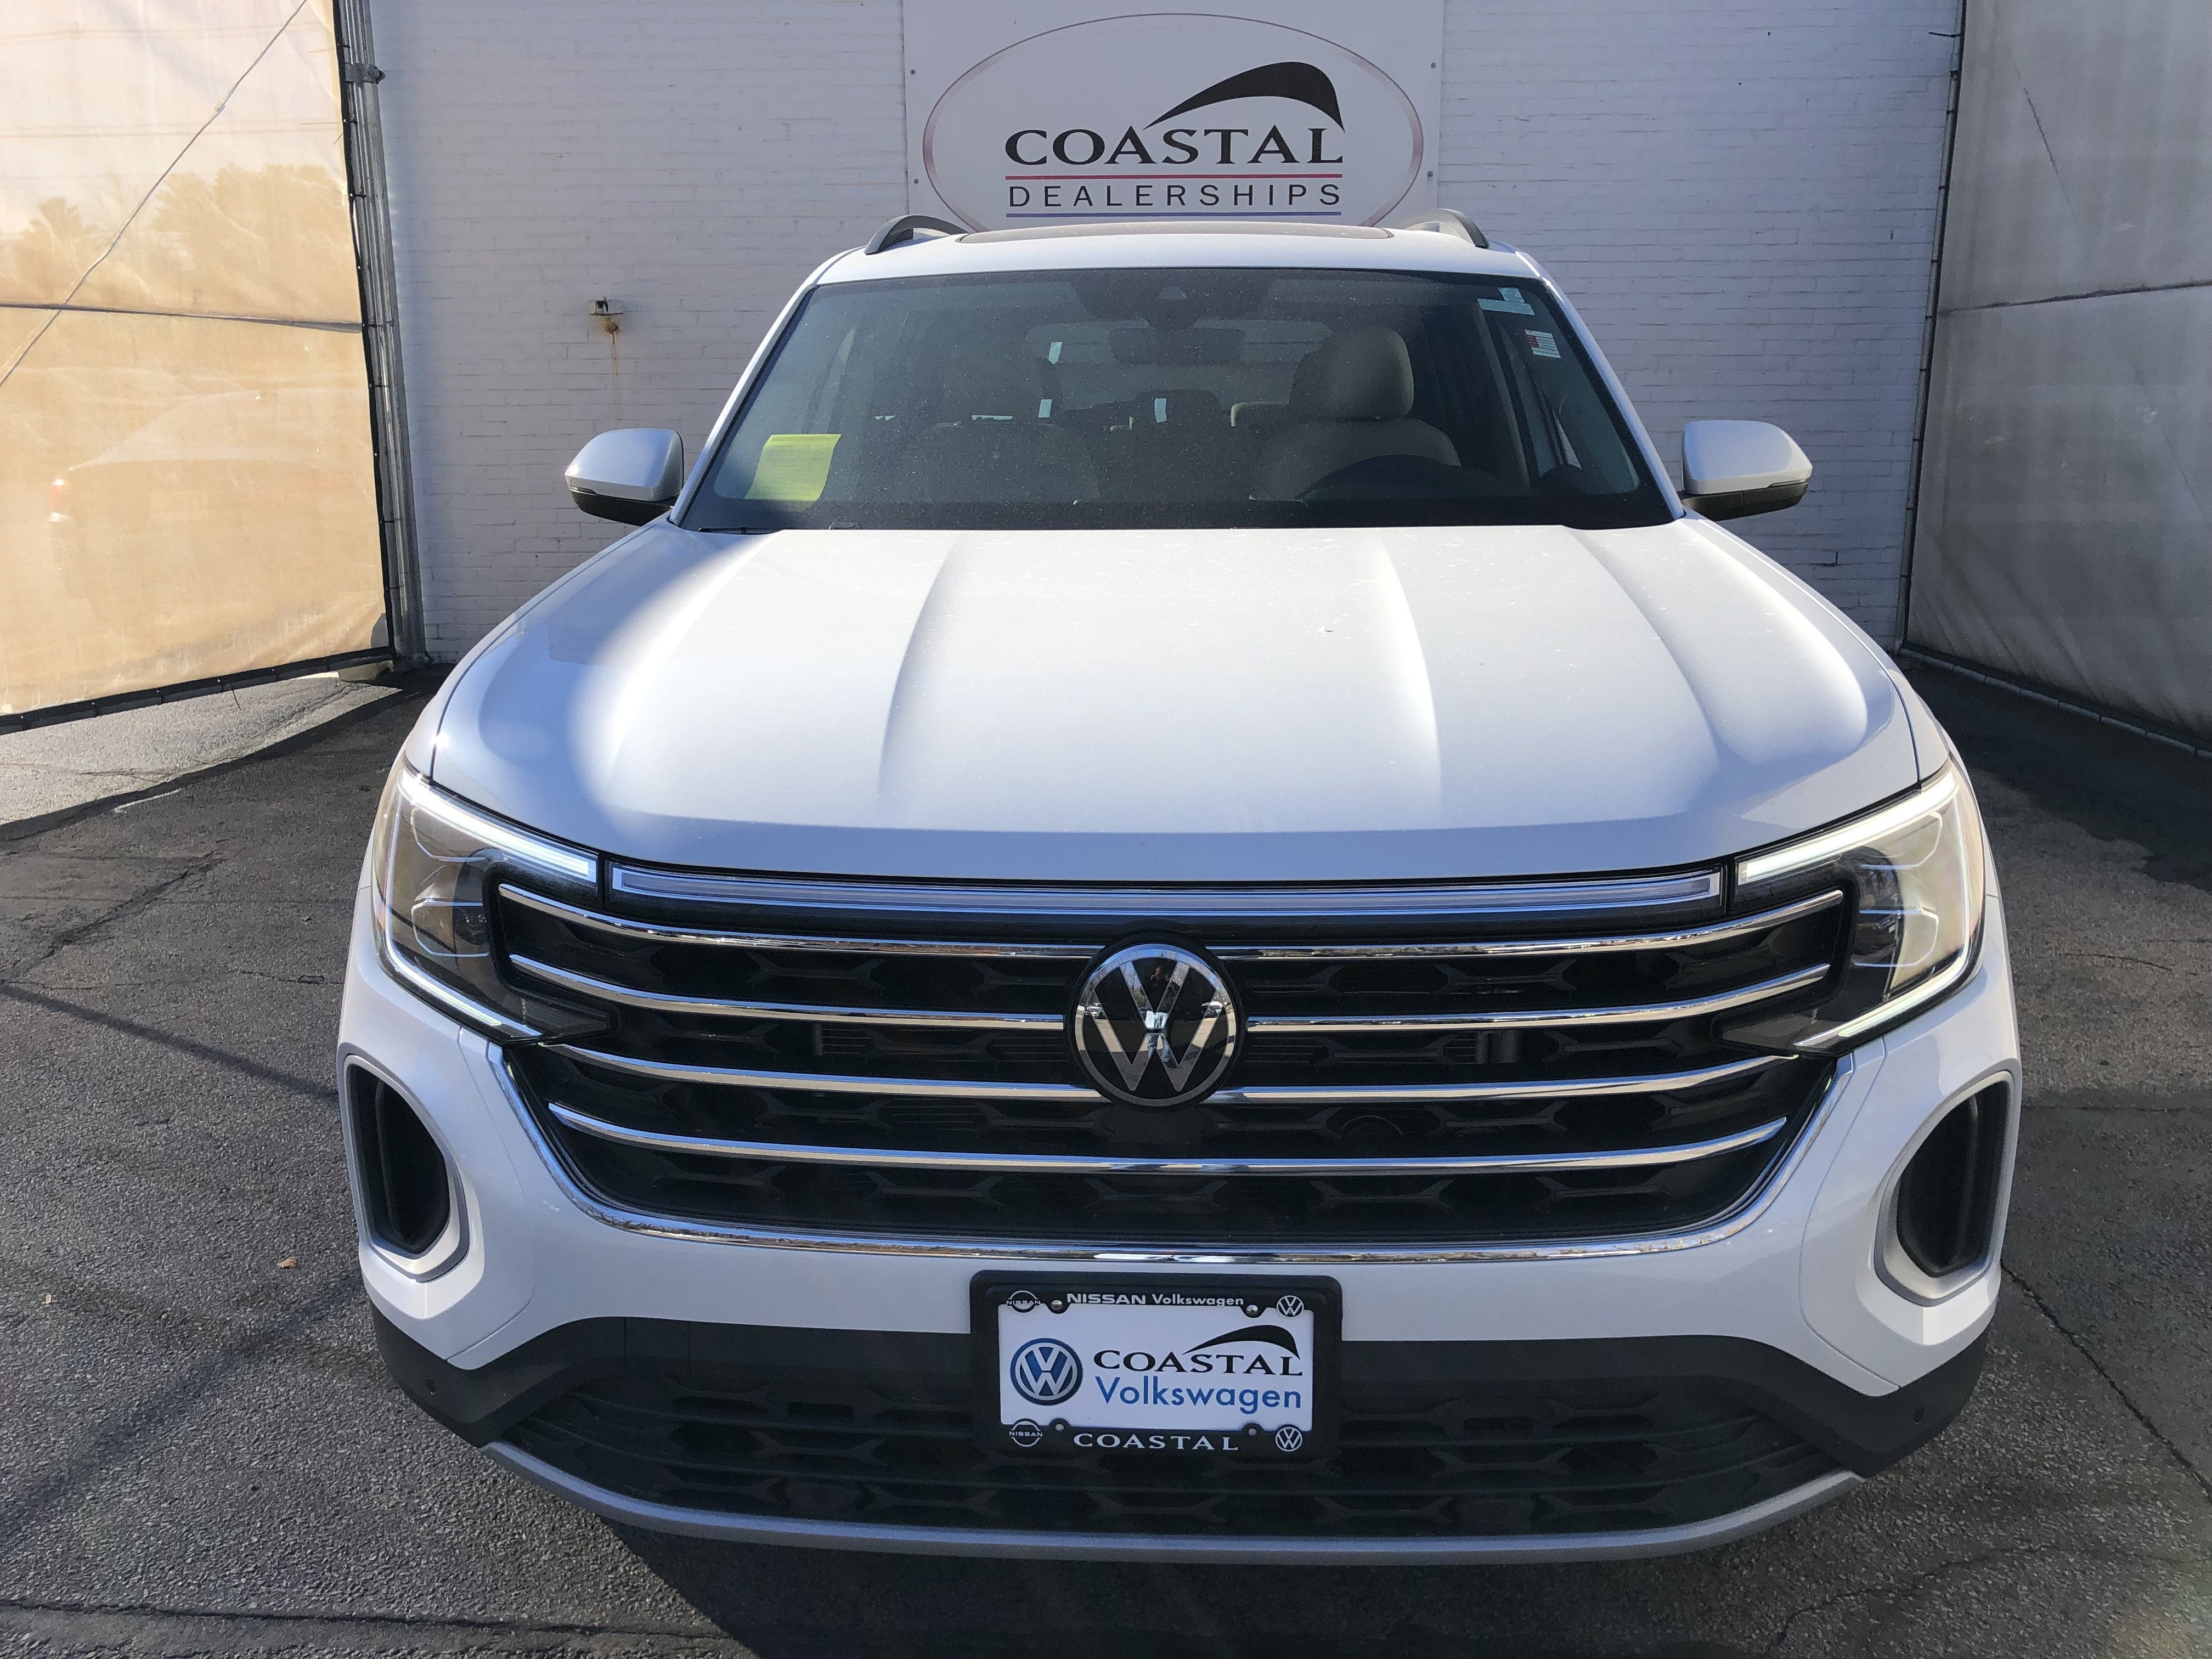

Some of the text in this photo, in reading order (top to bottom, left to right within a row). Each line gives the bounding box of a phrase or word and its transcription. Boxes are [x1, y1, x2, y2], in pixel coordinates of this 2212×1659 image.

[1005, 125, 1344, 165] COASTAL
[1010, 184, 1340, 207] DEALERSHIPS
[1082, 958, 1227, 1093] VW
[1066, 1293, 1244, 1306] NISSAN Volkswagen
[1093, 1350, 1303, 1376] COASTAL
[1095, 1375, 1301, 1415] Volkswagen
[1074, 1434, 1238, 1451] COASTAL
